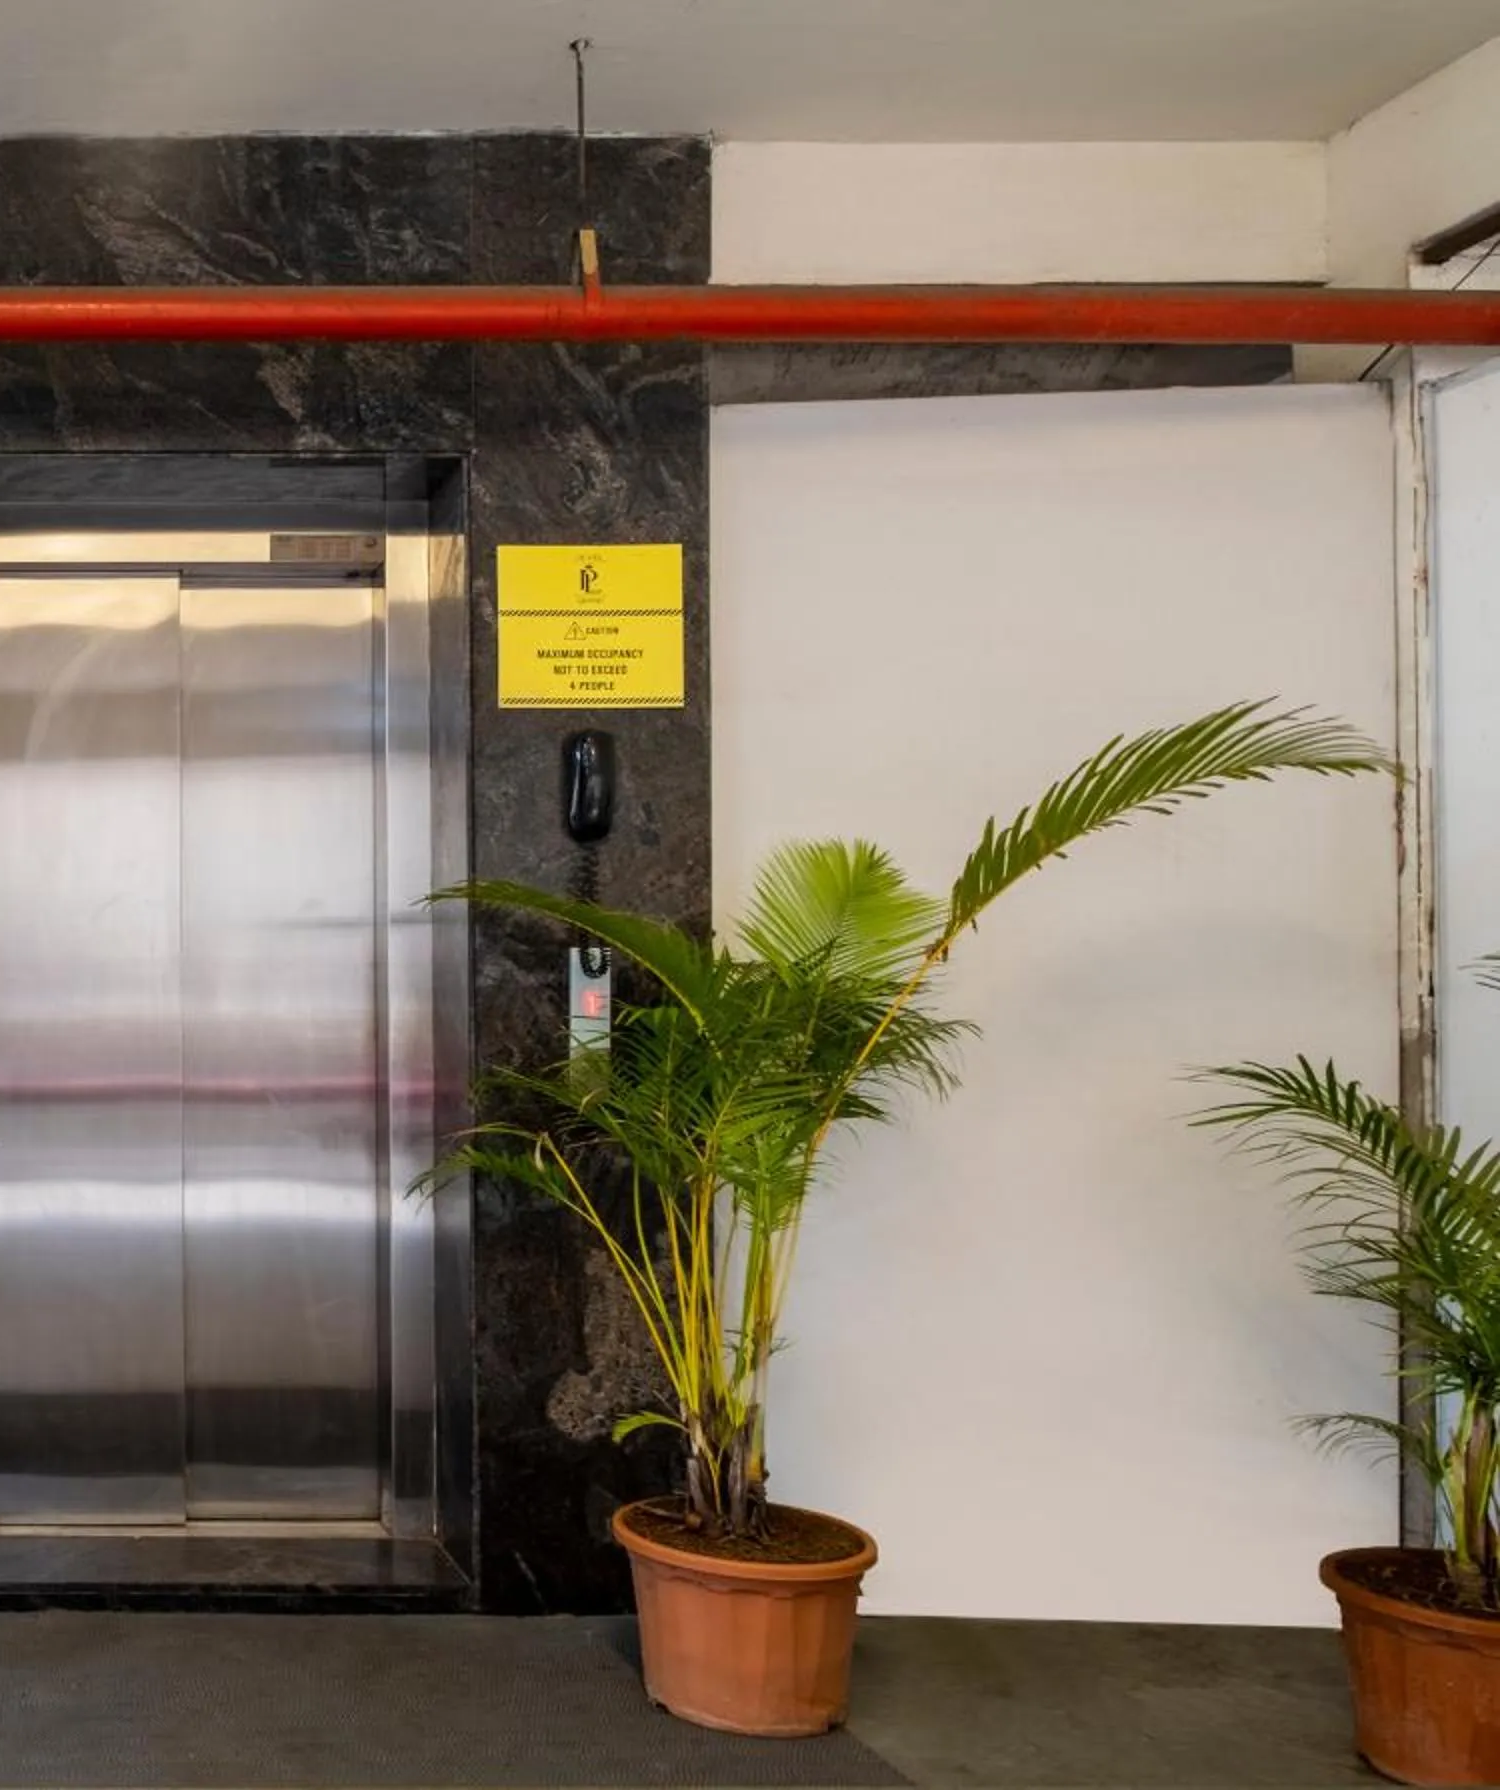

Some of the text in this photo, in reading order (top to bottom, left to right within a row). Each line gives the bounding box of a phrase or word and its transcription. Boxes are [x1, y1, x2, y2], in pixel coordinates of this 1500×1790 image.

[585, 626, 619, 635] CAUTION
[537, 649, 644, 659] MAXIMUM OCCUPANCY
[553, 665, 628, 675] NOT TO EXCEED
[579, 681, 615, 691] PEOPLE
